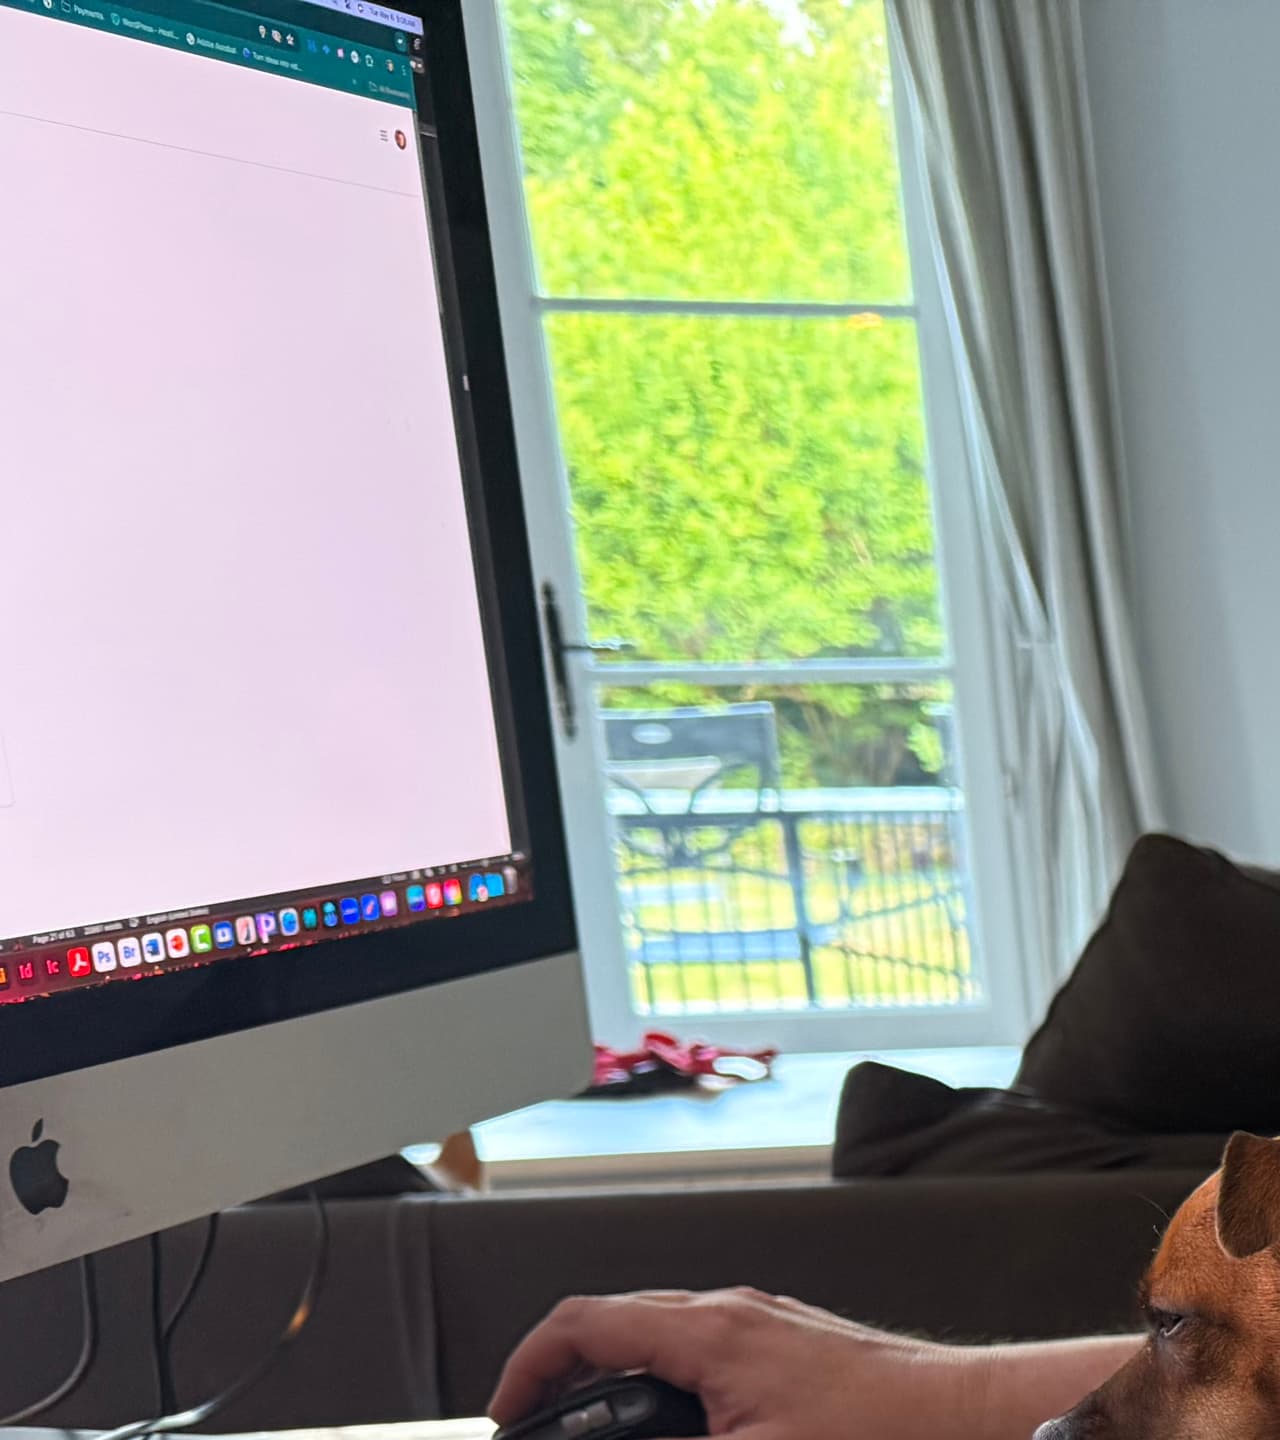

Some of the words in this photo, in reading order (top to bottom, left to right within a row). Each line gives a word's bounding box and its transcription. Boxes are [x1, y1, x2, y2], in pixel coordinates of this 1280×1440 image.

[97, 951, 111, 964] Ps
[123, 946, 136, 959] Br
[19, 962, 34, 979] Id
